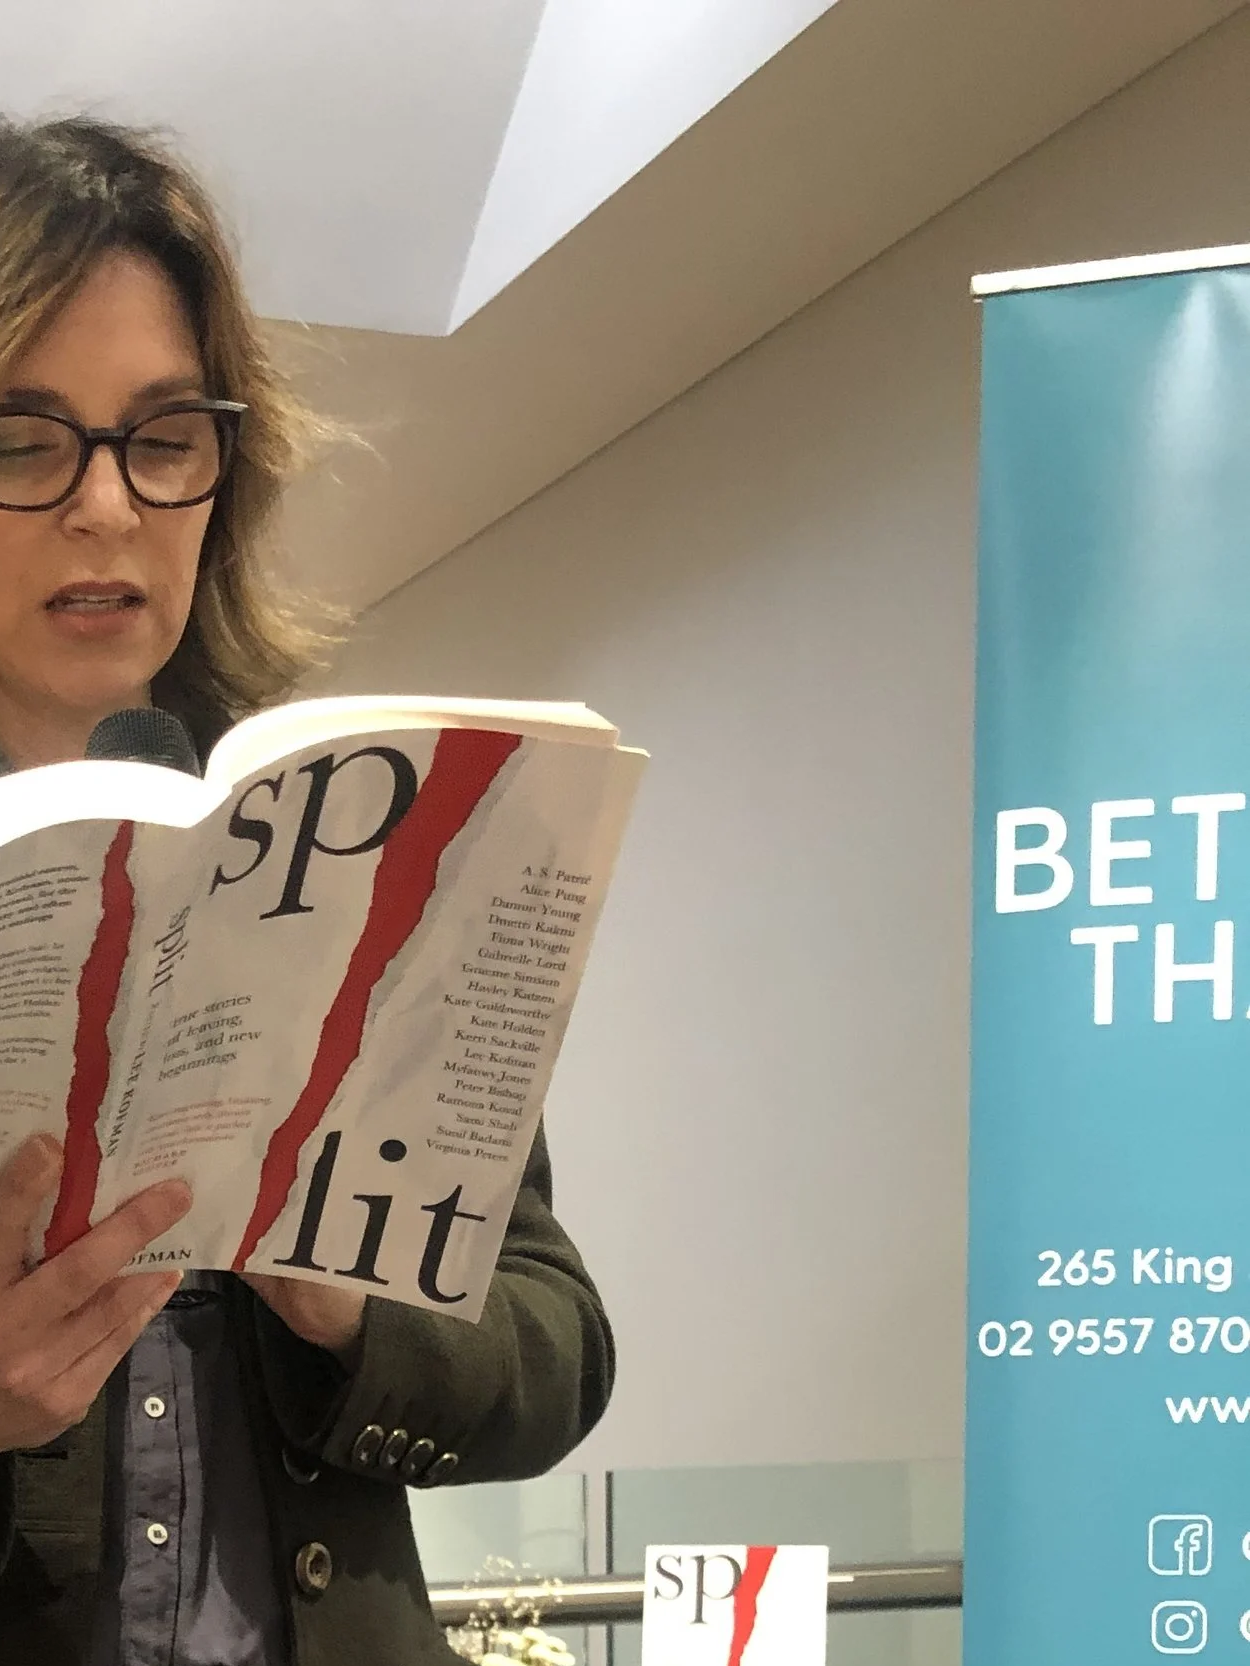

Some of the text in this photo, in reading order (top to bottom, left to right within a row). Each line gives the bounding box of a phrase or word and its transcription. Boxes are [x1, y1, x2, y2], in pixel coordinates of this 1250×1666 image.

[210, 746, 418, 921] sp
[996, 793, 1246, 914] BET
[542, 903, 582, 923] Young
[491, 931, 571, 955] Fiona Wright
[536, 957, 566, 971] Lord
[1070, 920, 1250, 1025] TH
[203, 994, 252, 1015] stories
[443, 993, 472, 1008] Kate
[470, 1015, 546, 1037] Kate Holden
[194, 1032, 225, 1051] and
[229, 1030, 261, 1044] new
[490, 1035, 541, 1054] Sackville
[465, 1048, 483, 1060] Lee
[158, 1051, 238, 1082] beginnings
[455, 1079, 485, 1092] Peter
[497, 1071, 531, 1085] Jones
[273, 1129, 487, 1304] lit
[1037, 1248, 1233, 1293] 265 King
[978, 1316, 1250, 1357] 02 9557 870
[654, 1553, 743, 1624] sp
